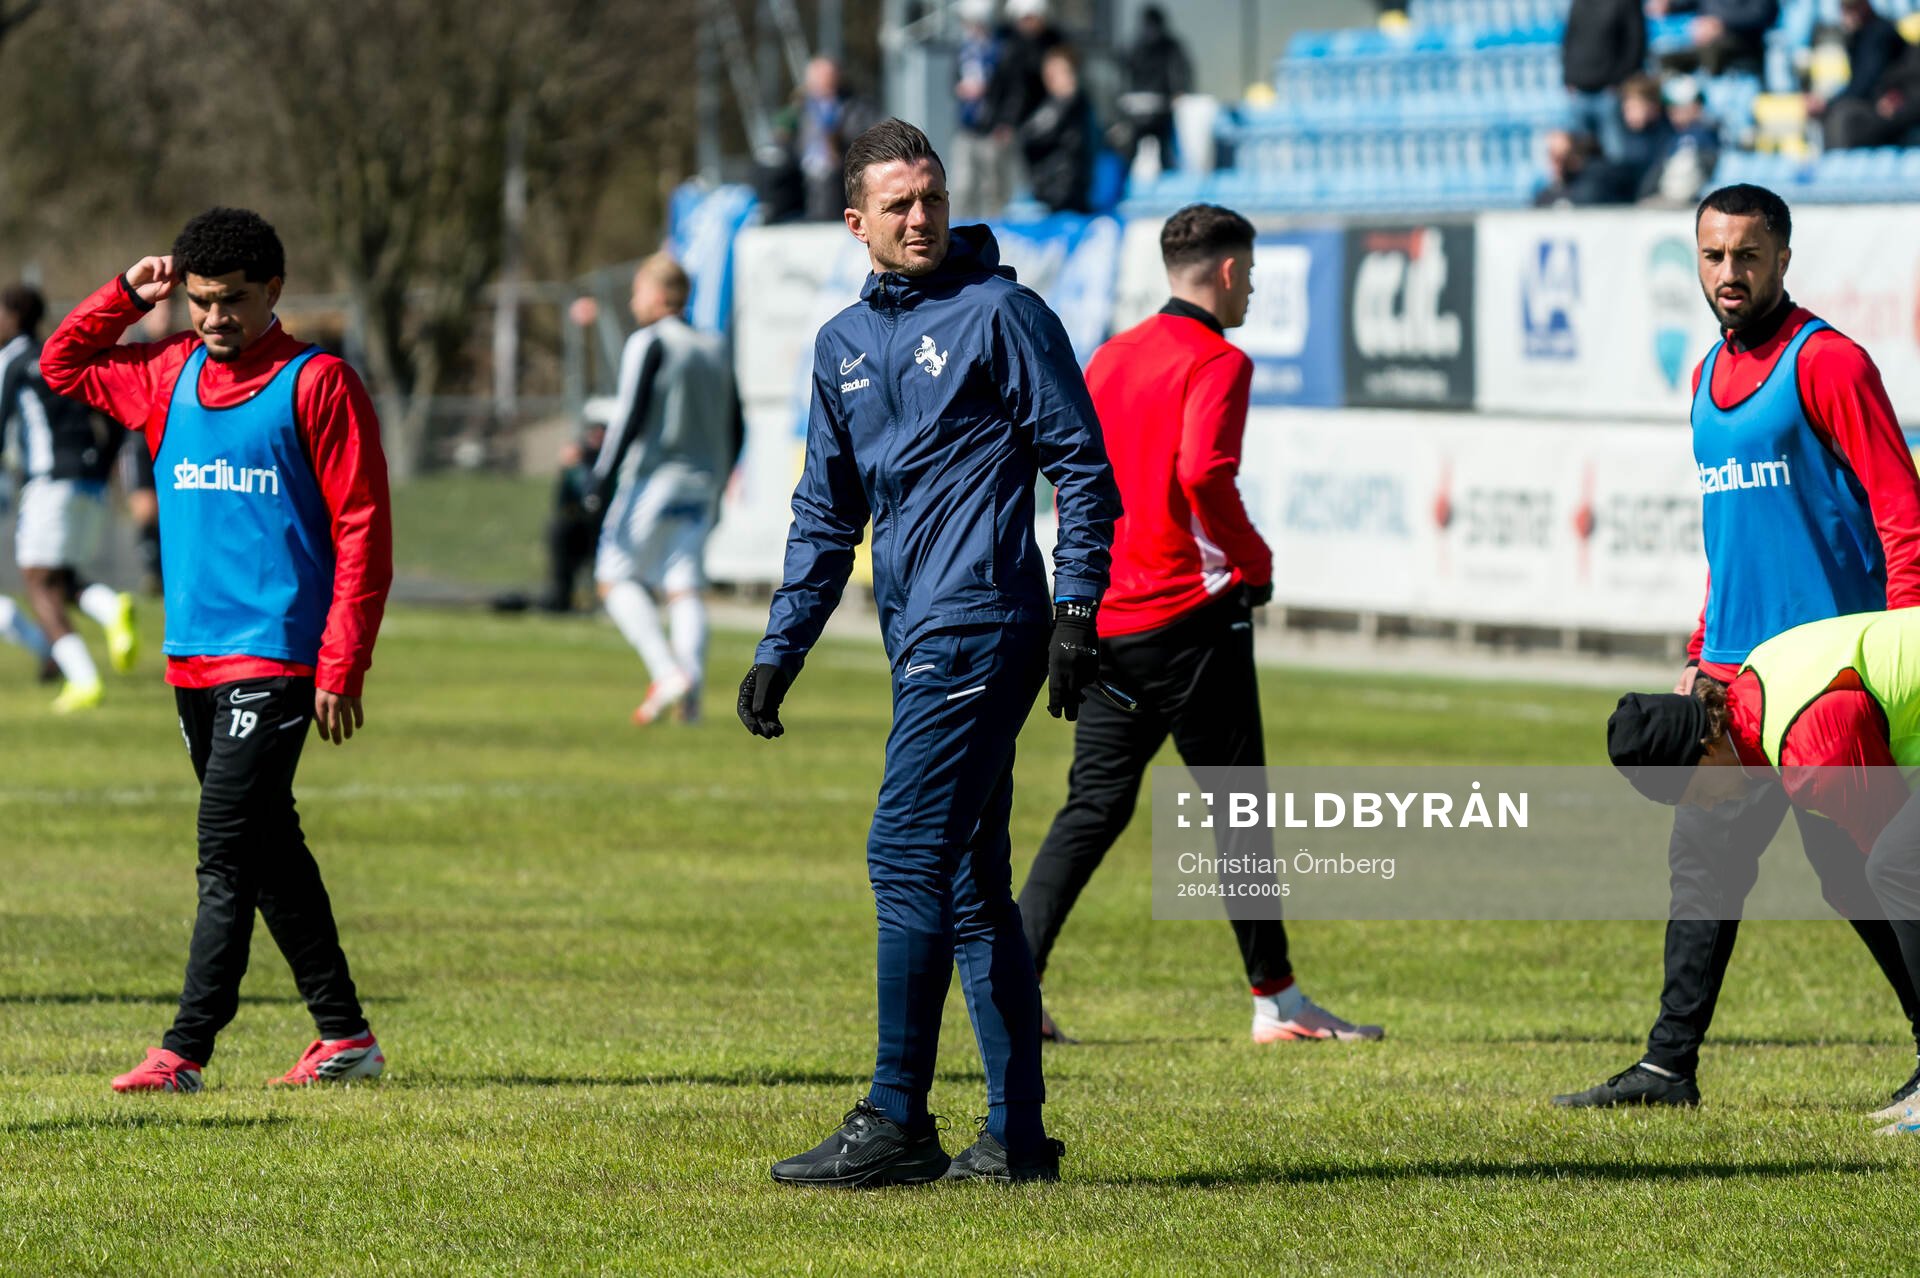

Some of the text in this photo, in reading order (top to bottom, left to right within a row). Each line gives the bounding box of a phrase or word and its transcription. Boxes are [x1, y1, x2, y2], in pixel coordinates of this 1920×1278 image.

[840, 377, 870, 394] stadium
[173, 457, 279, 495] stadium
[228, 708, 258, 739] 19
